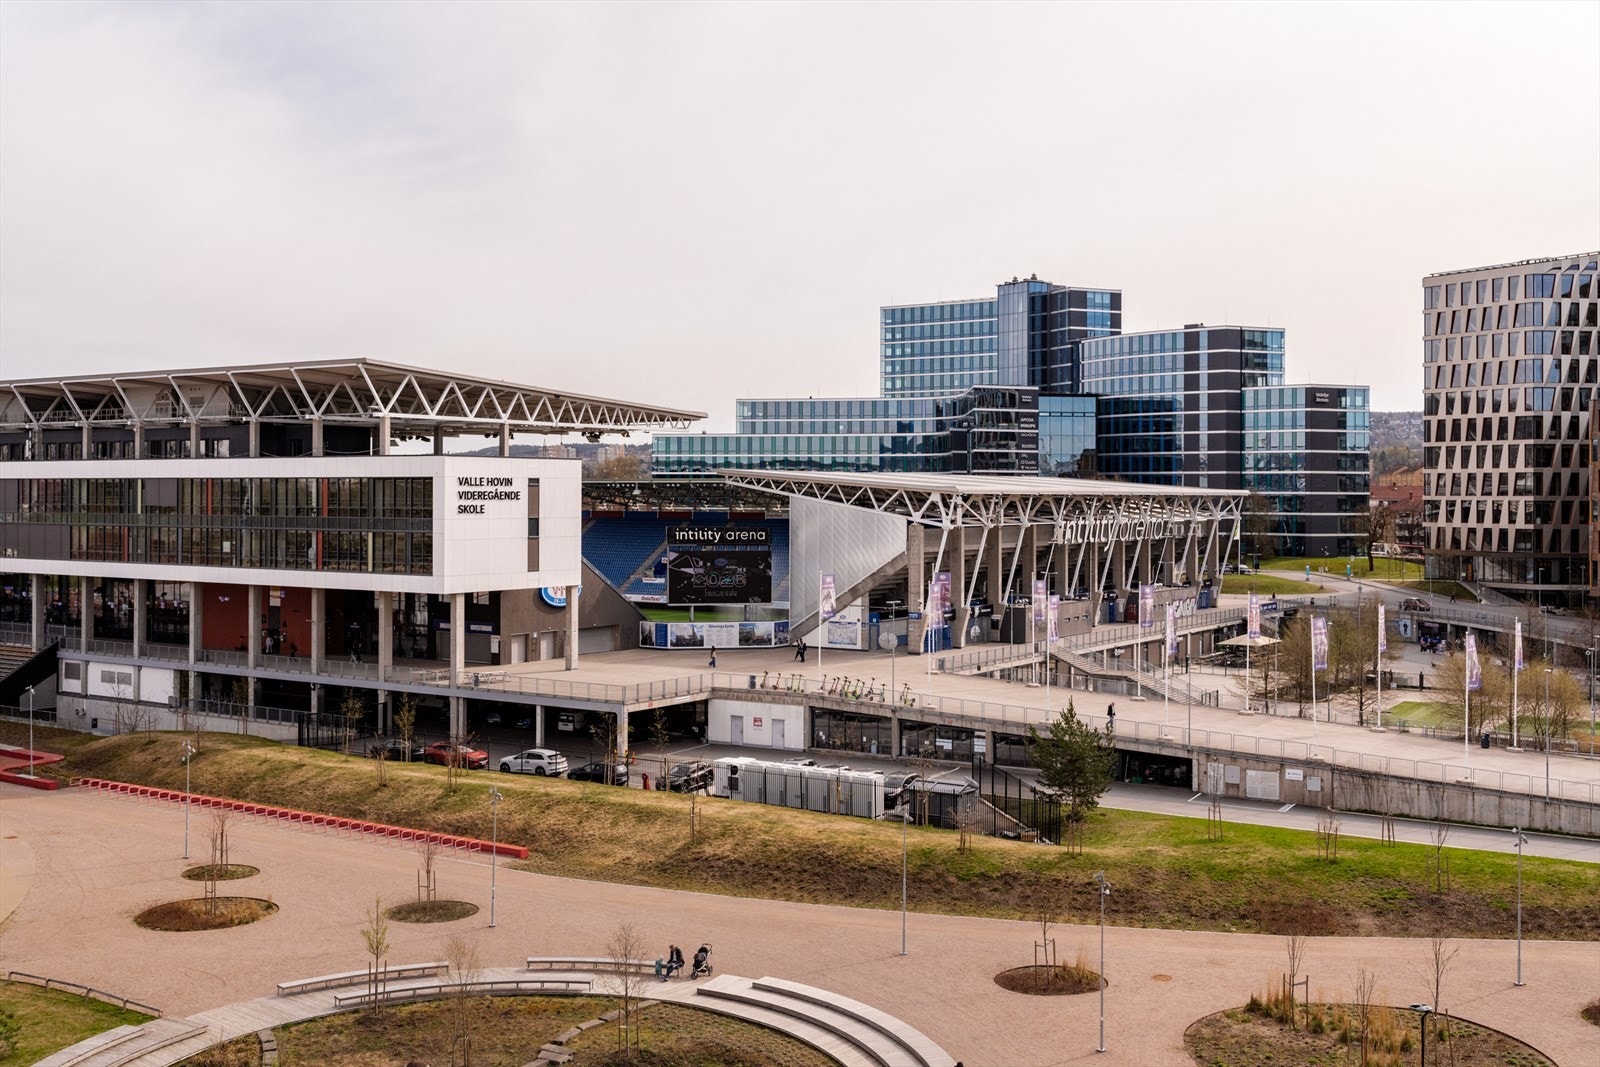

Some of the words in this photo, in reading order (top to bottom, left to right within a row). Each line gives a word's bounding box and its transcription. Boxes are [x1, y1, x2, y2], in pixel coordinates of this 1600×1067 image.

[458, 477, 485, 486] VALLE
[486, 478, 512, 486] HOVIN
[458, 488, 520, 500] VIDEREGÅENDE
[458, 504, 485, 514] SKOLE
[675, 527, 721, 543] intility
[726, 531, 766, 541] arena
[1060, 512, 1118, 552] intlity
